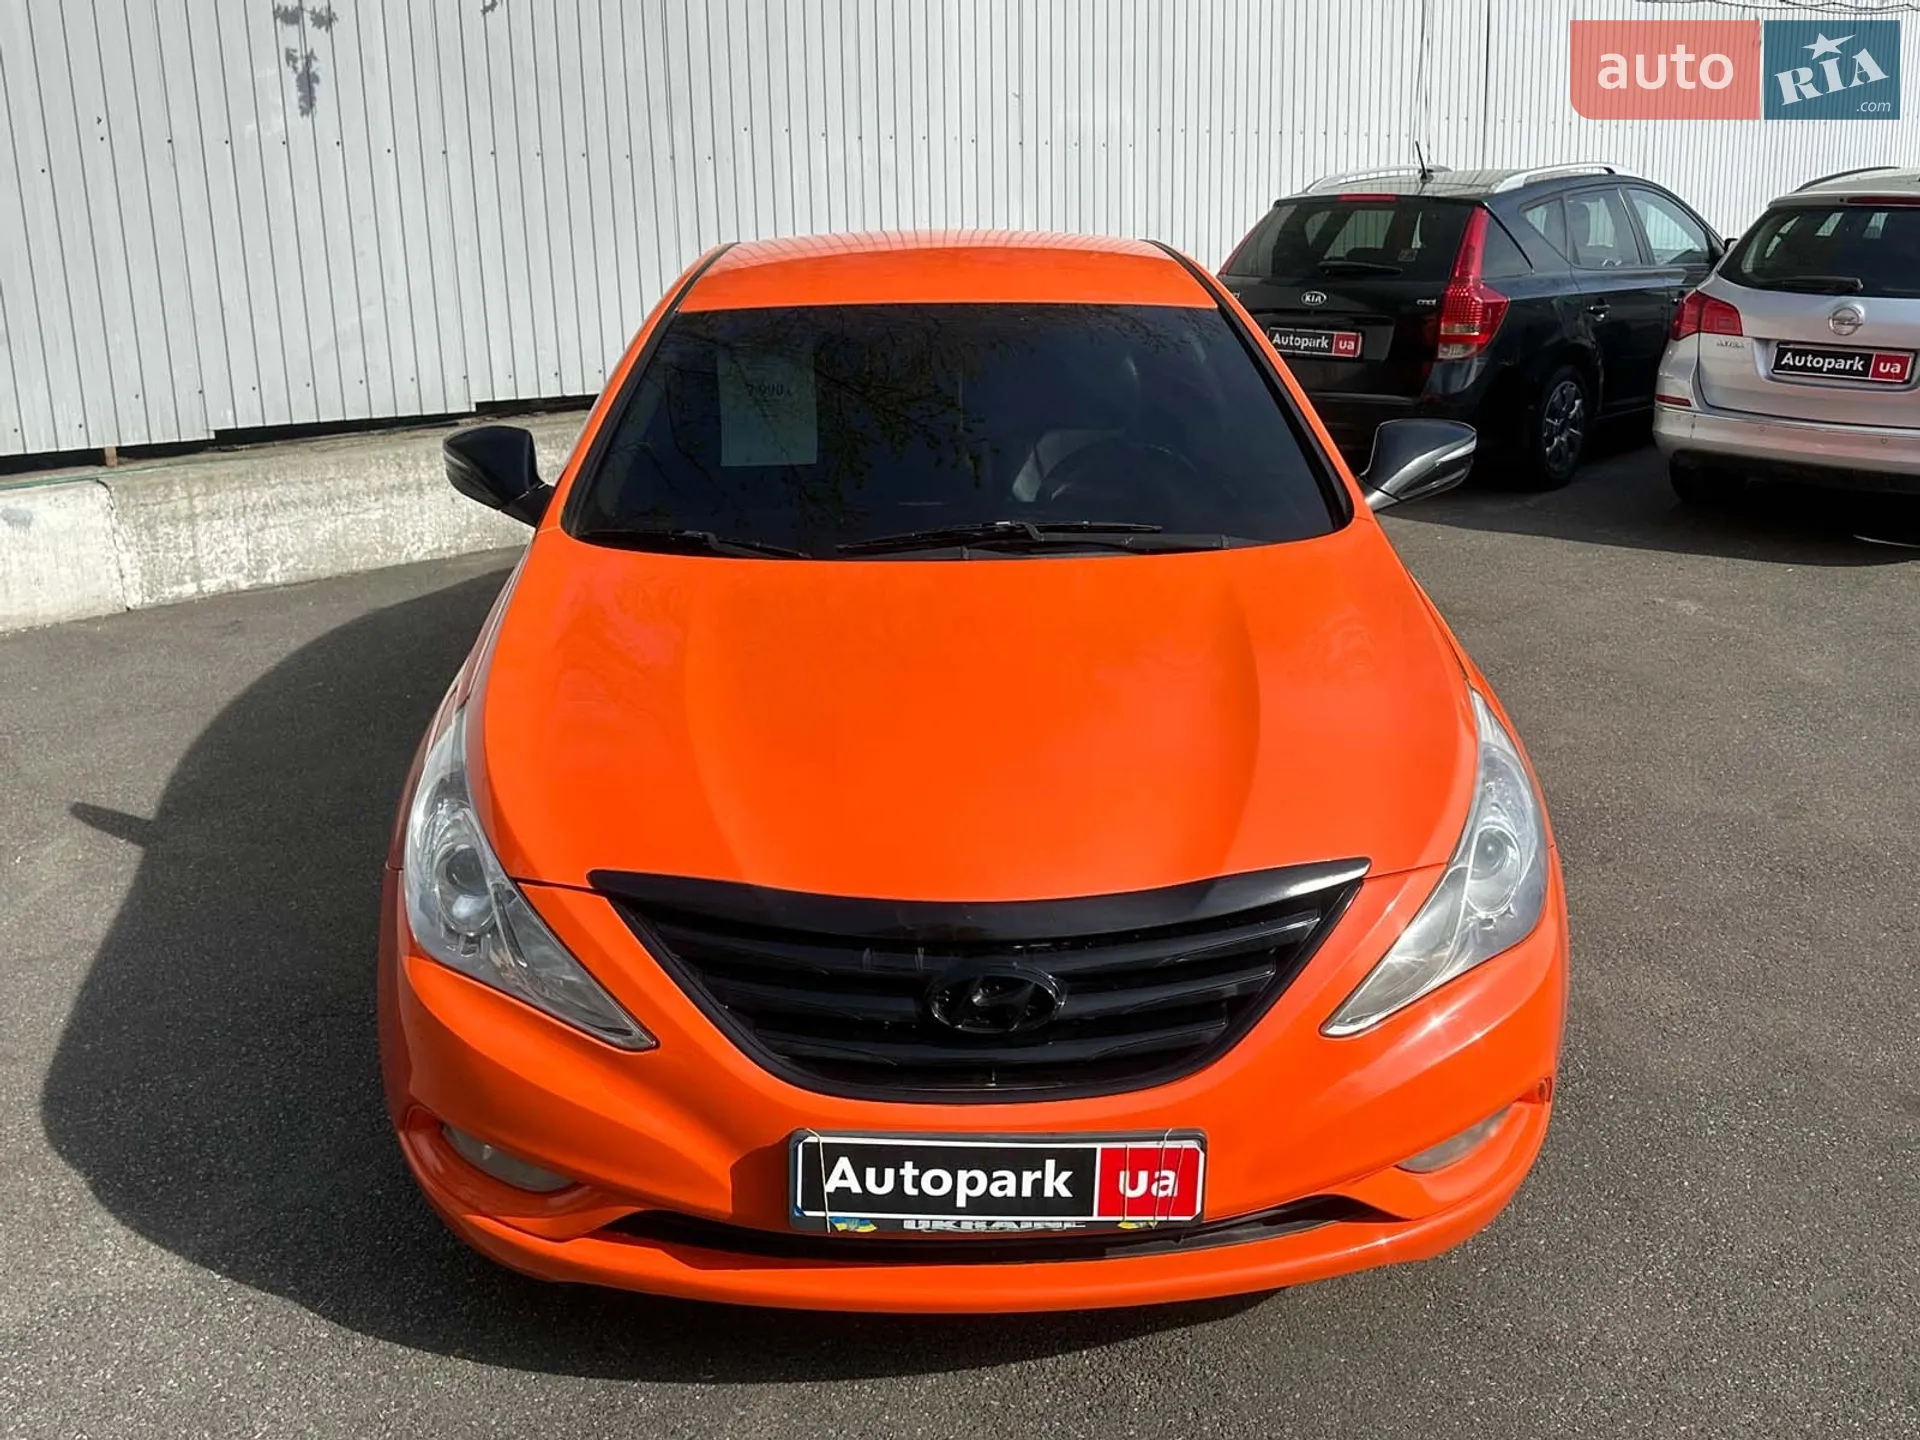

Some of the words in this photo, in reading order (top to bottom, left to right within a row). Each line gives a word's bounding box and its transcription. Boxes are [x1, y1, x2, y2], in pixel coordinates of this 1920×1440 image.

[1304, 293, 1322, 304] KIA
[1272, 333, 1329, 350] Autopark
[1338, 339, 1355, 350] ua
[1781, 352, 1865, 372] Autopark
[1878, 361, 1902, 374] ua
[824, 1156, 1074, 1208] Autopark
[1118, 1169, 1179, 1199] ua
